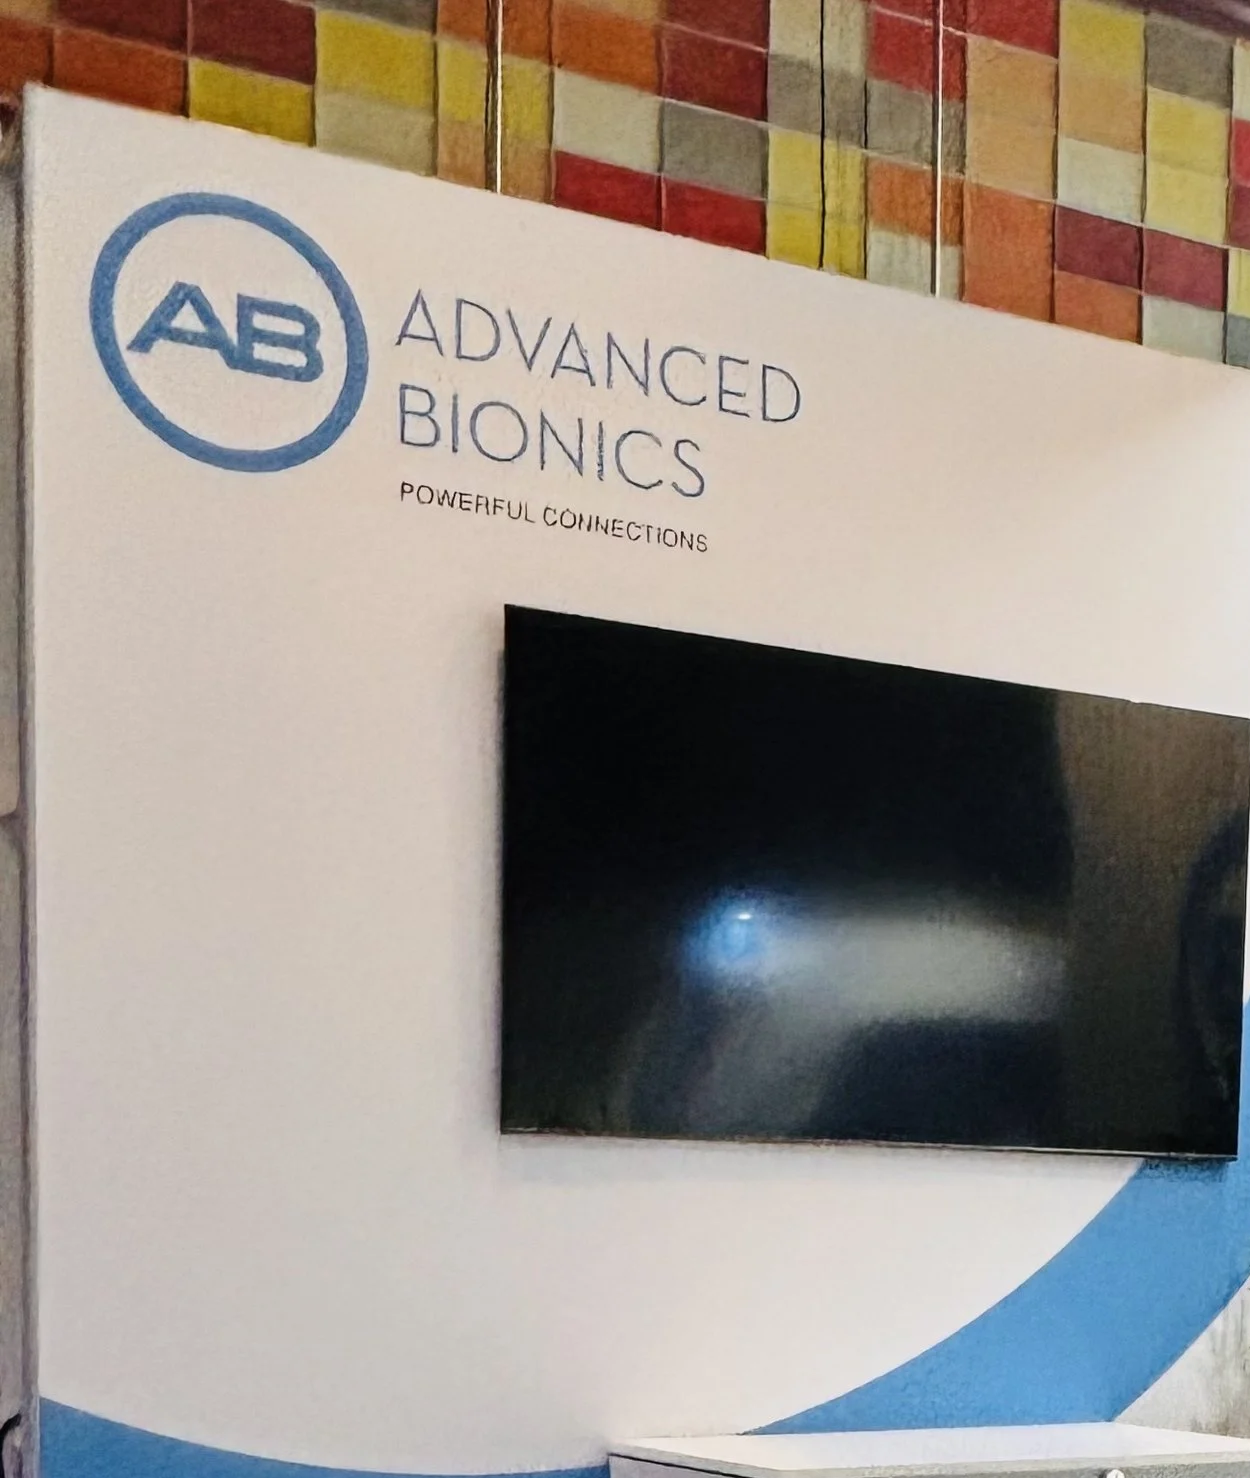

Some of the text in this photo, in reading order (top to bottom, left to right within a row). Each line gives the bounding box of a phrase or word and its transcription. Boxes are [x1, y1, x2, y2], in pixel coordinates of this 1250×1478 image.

[126, 281, 323, 382] AB
[396, 290, 802, 423] ADVANCED
[399, 384, 706, 498] BIONICS
[400, 482, 709, 552] POWERFUL CONNECTIONS
